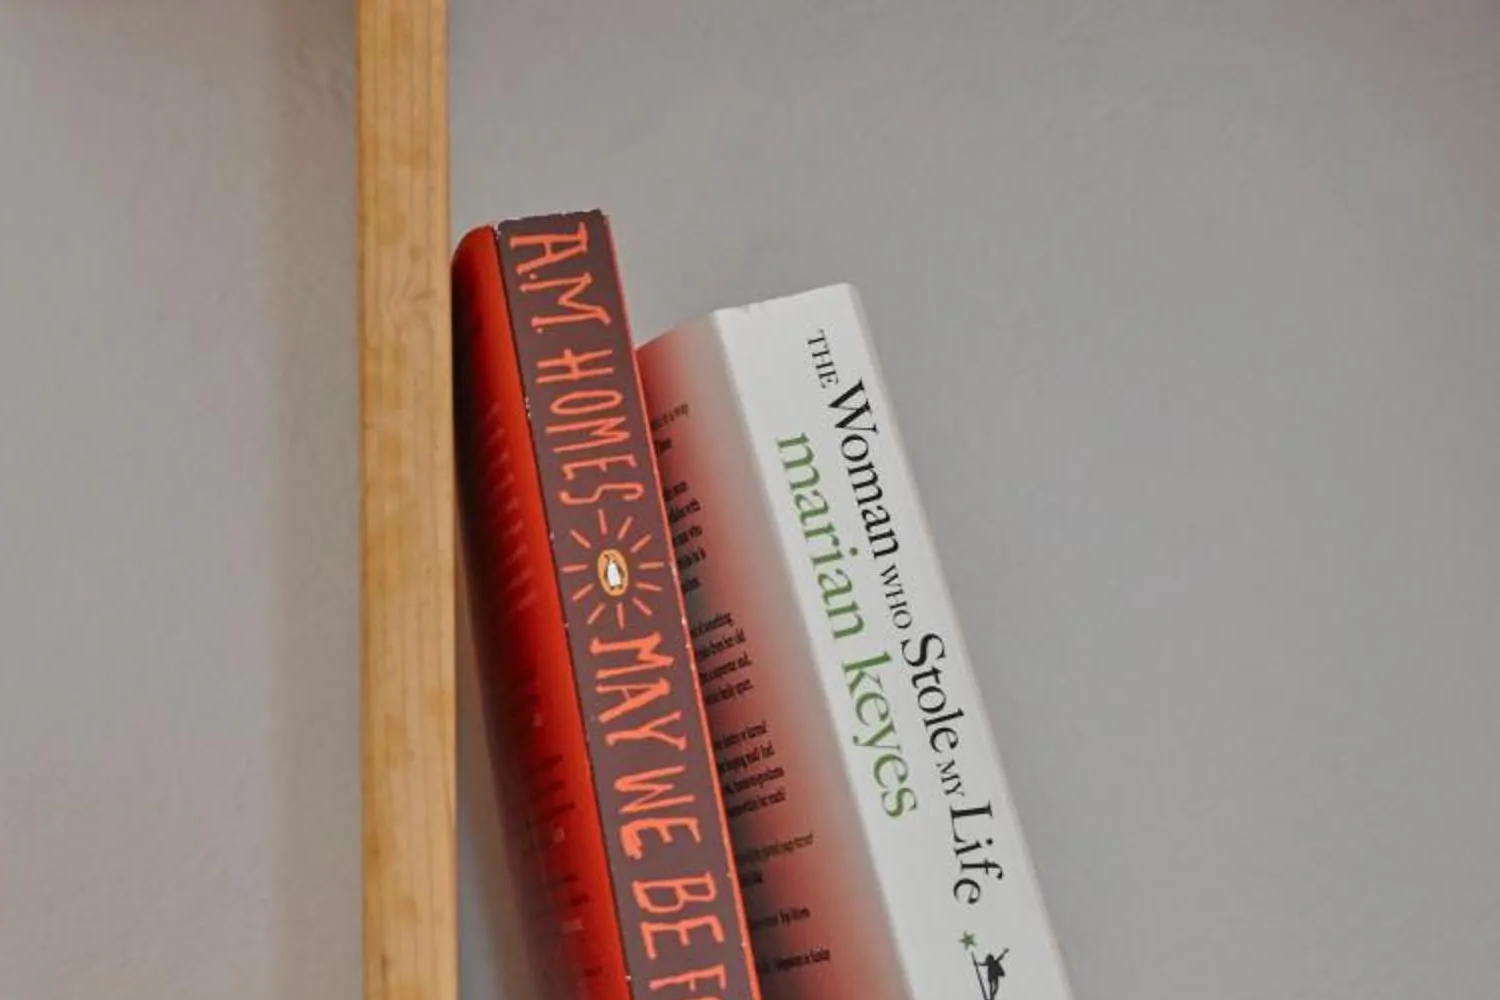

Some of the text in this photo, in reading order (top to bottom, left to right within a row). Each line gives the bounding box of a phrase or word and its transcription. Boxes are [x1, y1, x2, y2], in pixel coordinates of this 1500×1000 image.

[509, 221, 645, 507] A.M. HOMES
[589, 630, 687, 752] MAY
[775, 431, 918, 819] marian keyes
[806, 328, 1004, 906] THE Woman WHO Stole MY Life
[614, 763, 701, 860] WE
[631, 871, 725, 960] BE
